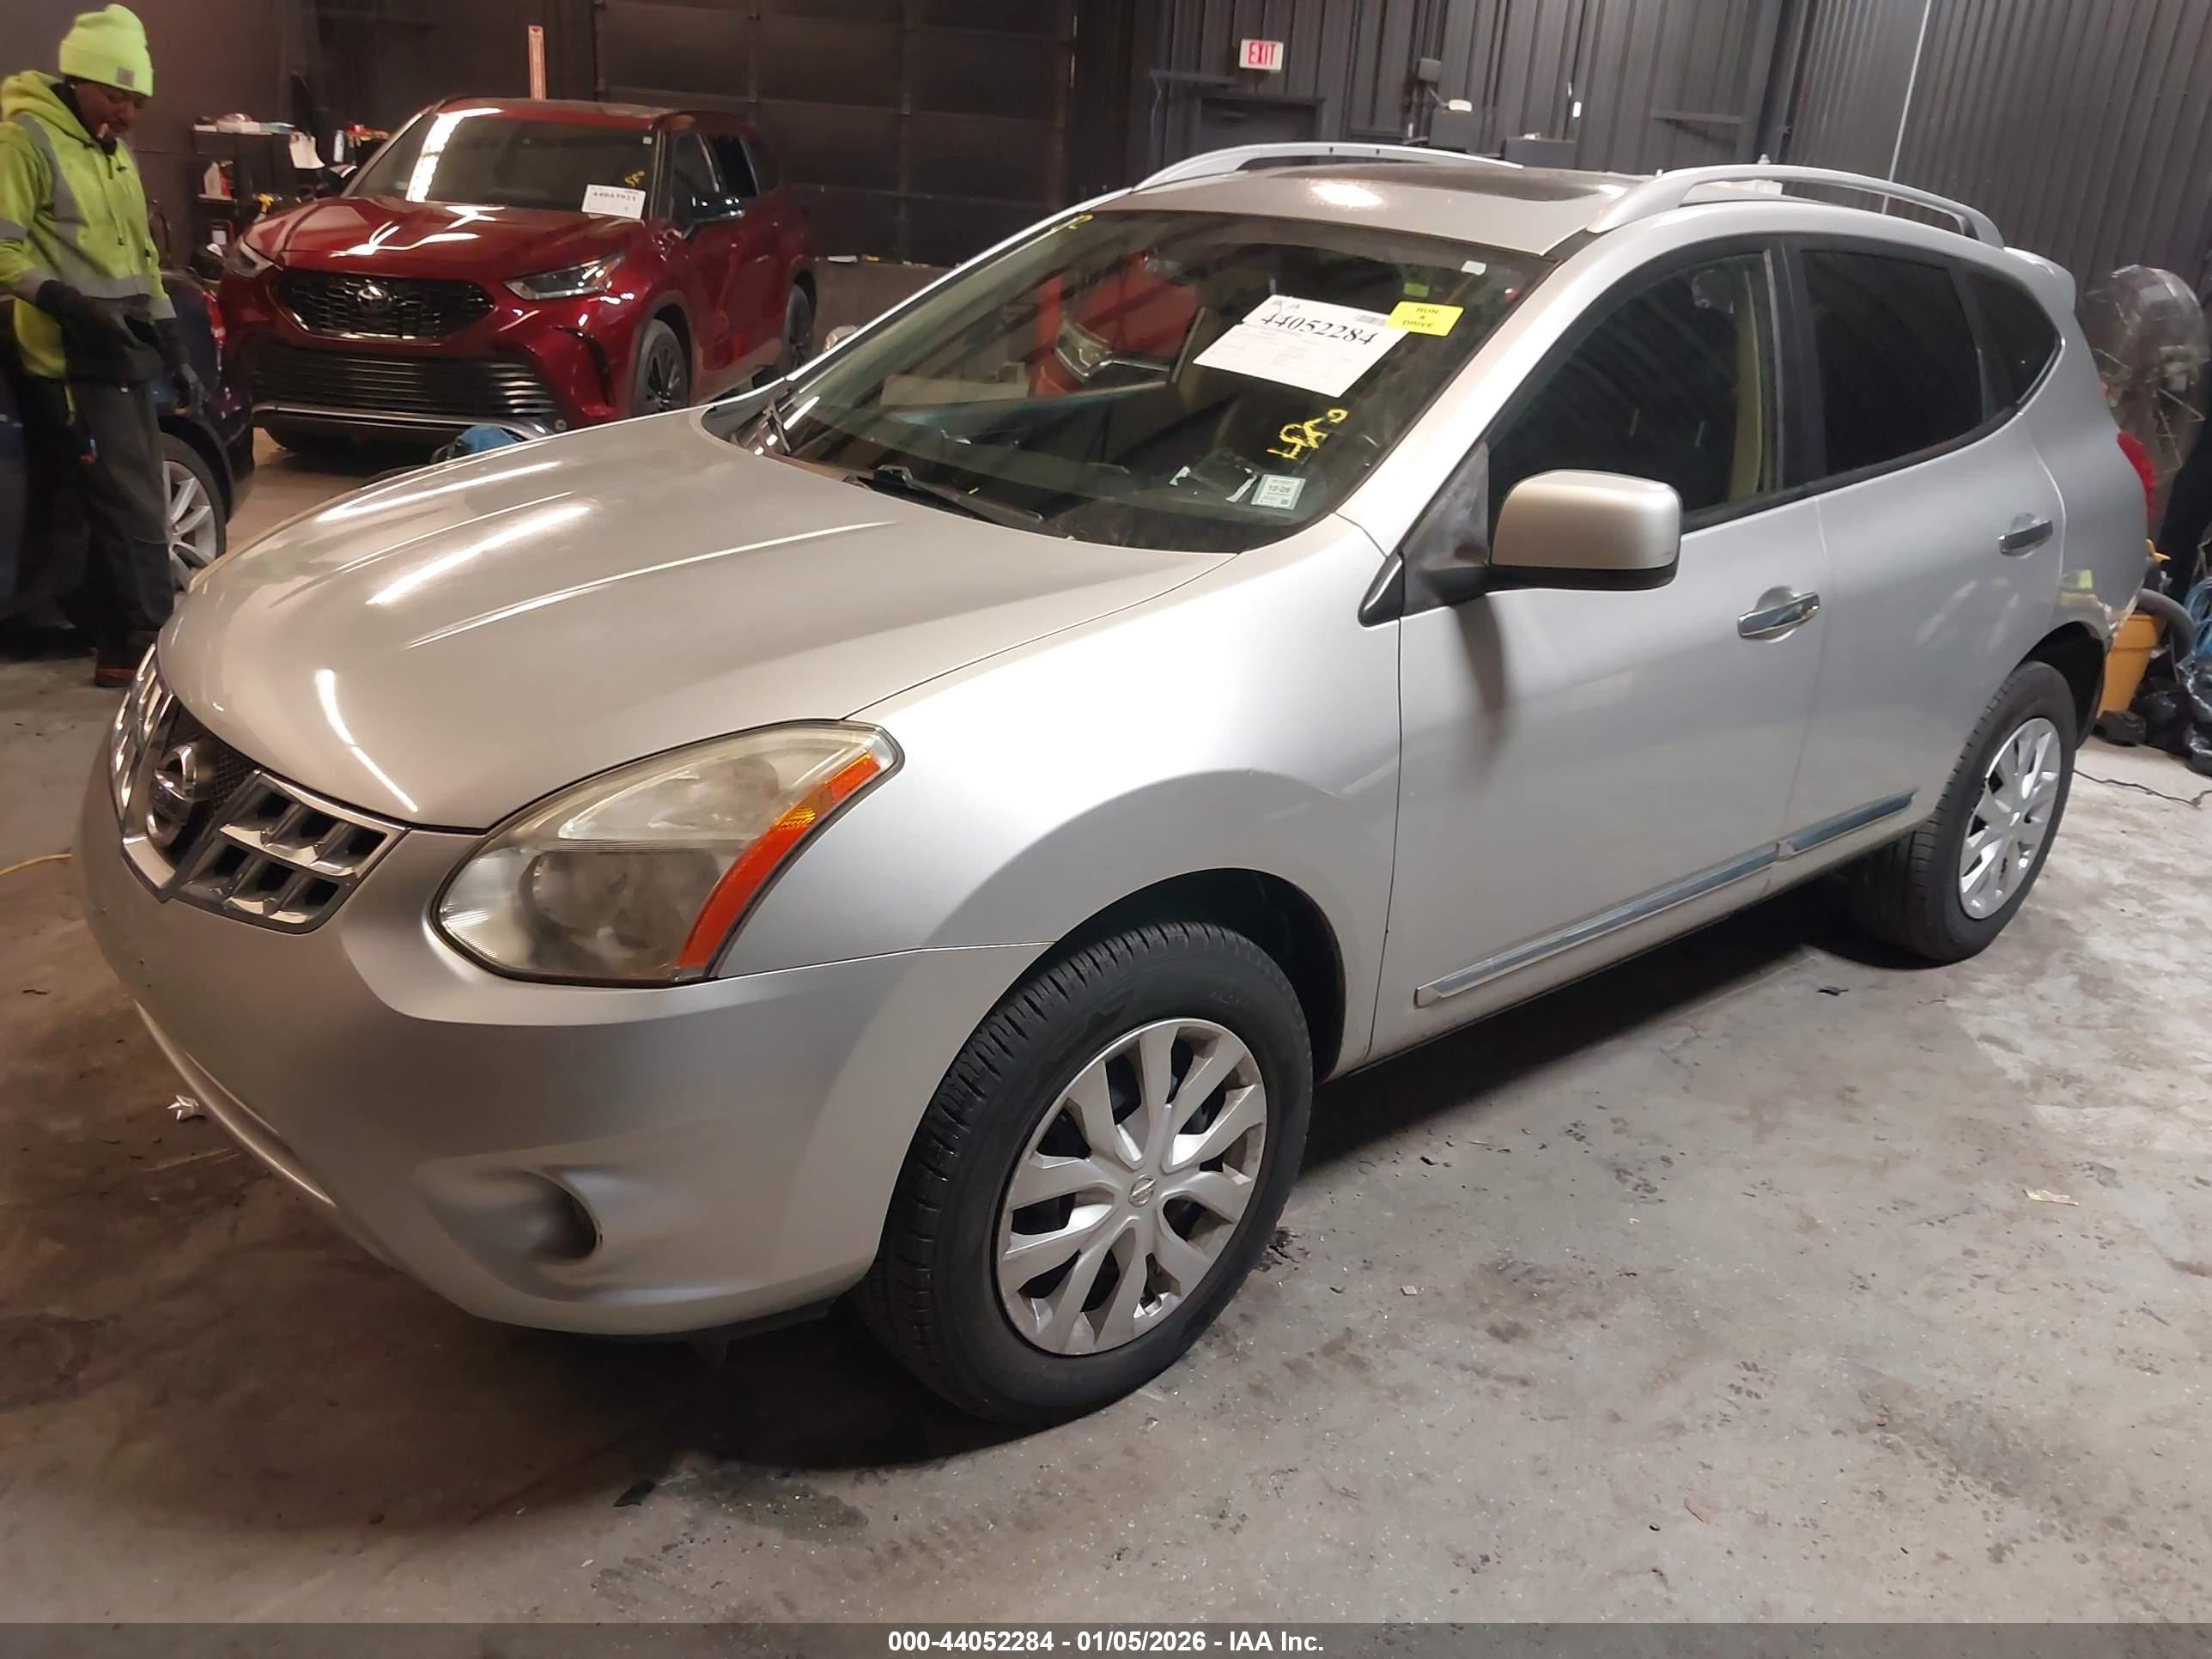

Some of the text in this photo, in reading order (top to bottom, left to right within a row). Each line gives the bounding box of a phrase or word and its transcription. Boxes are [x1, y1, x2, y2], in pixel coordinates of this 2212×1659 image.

[1248, 42, 1278, 65] EXIT
[1261, 313, 1379, 345] 44052284
[1402, 319, 1434, 328] DRIVE
